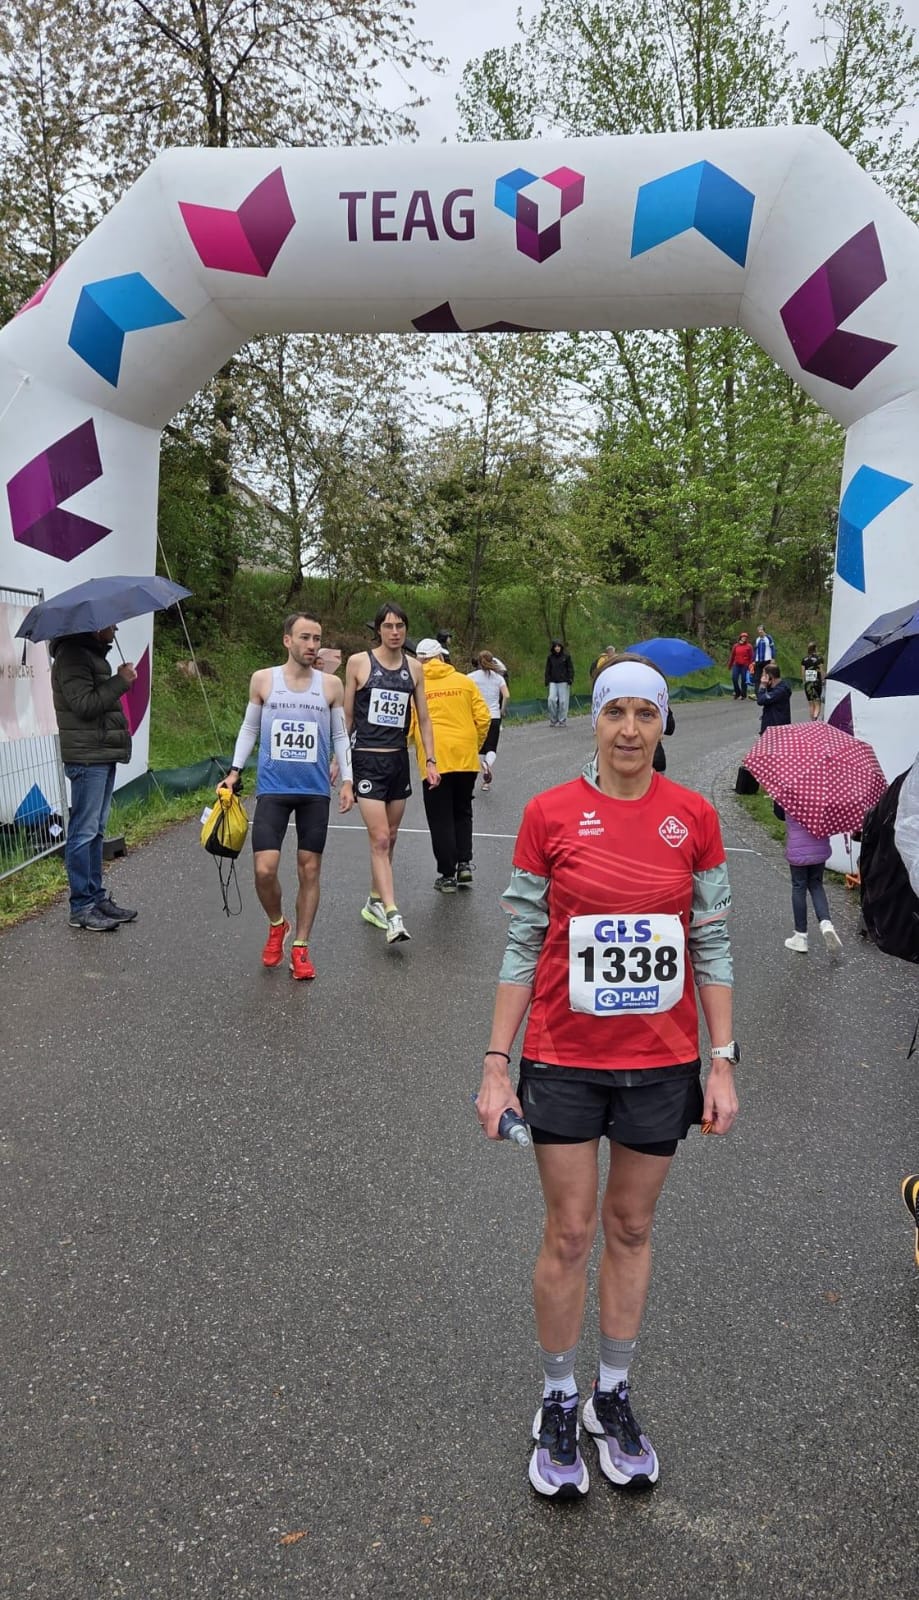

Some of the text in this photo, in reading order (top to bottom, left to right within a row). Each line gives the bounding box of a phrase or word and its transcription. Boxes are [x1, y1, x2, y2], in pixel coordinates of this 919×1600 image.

[339, 188, 475, 242] TEAG
[380, 691, 399, 701] GLS
[373, 699, 405, 716] 1433
[281, 722, 305, 733] GLS
[274, 732, 315, 749] 1440
[577, 946, 678, 983] 1338
[622, 991, 657, 1002] PLAN
